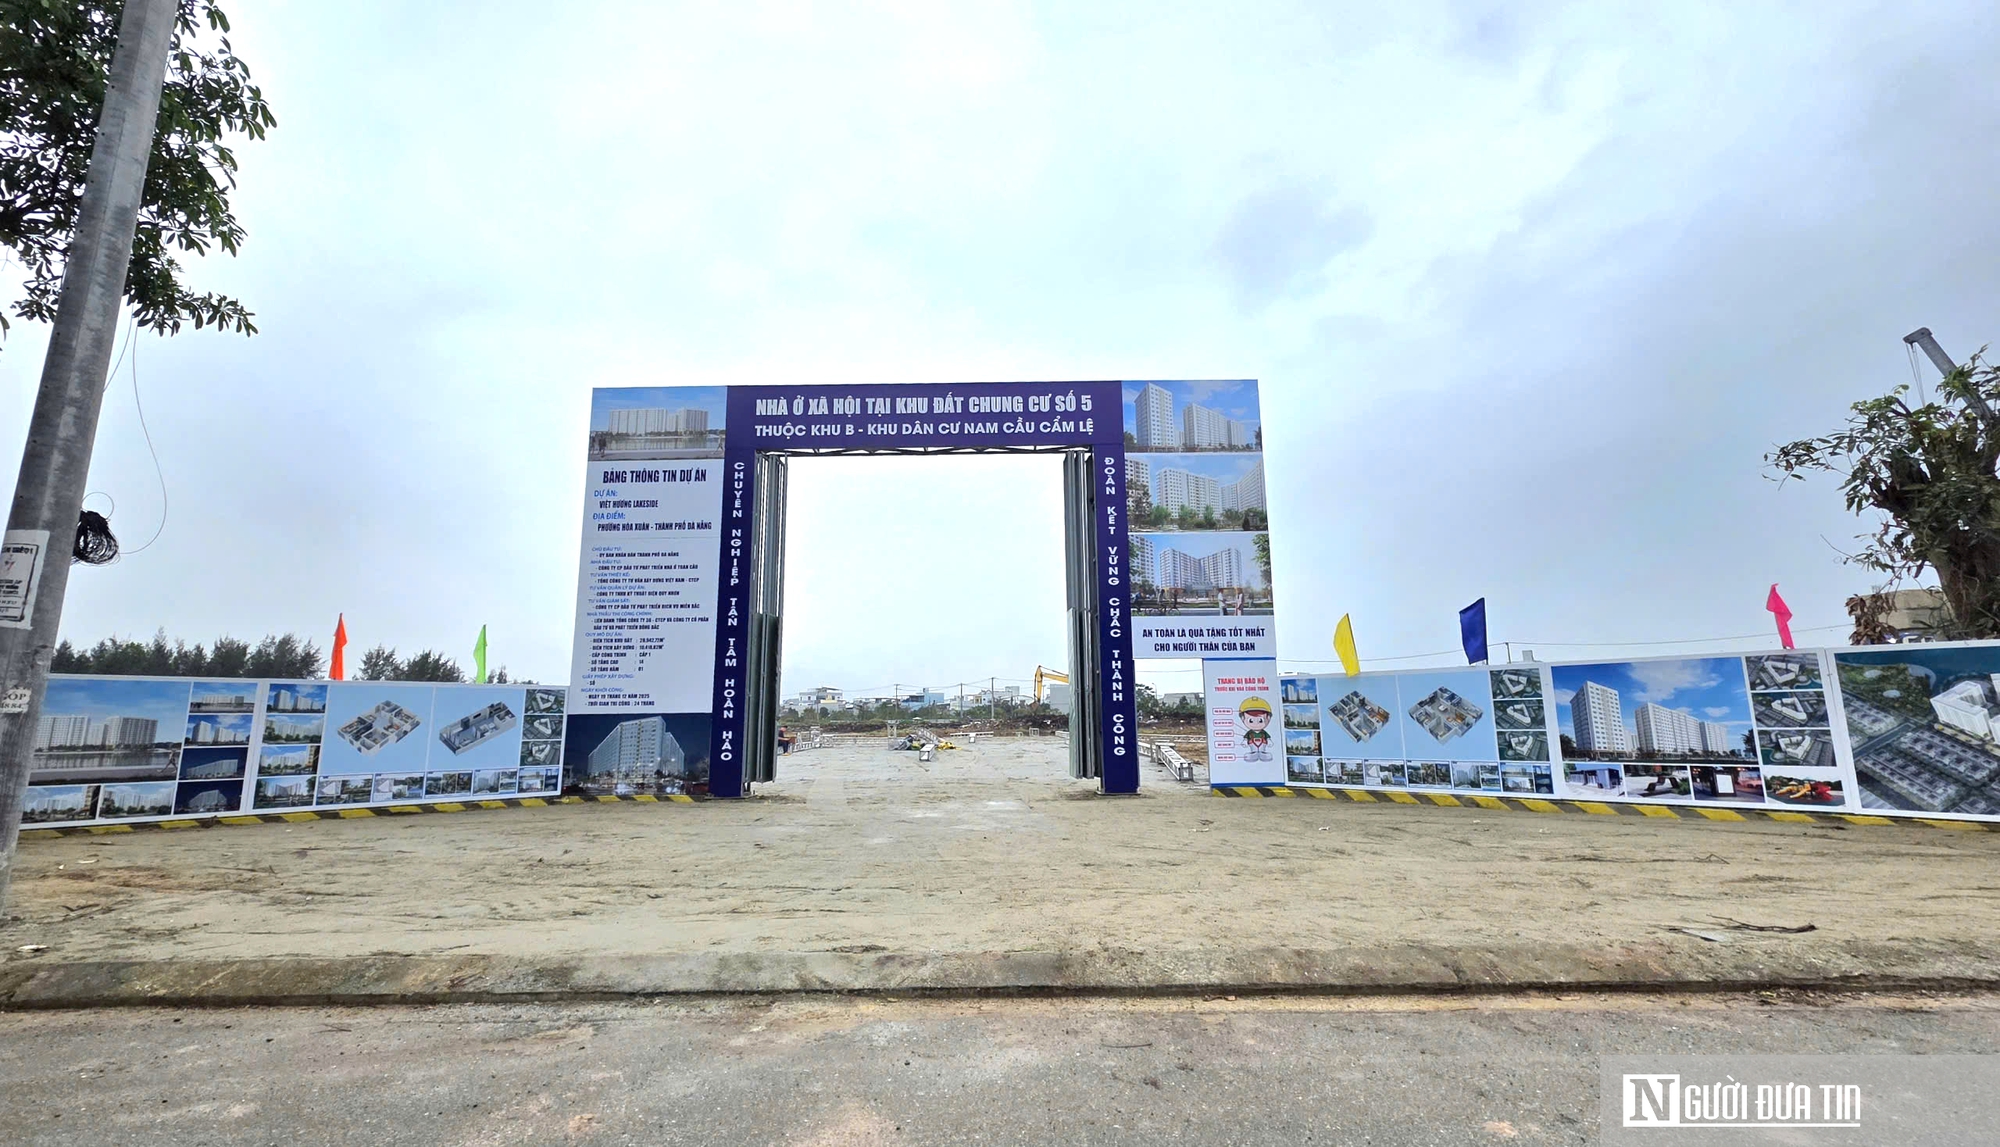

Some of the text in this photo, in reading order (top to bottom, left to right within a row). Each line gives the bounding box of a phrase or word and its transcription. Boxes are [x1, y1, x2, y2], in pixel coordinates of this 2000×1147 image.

[756, 390, 1093, 418] NHÀ Ở XÃ HỘI TẠI KHU ĐẤT CHUNG CƯ SỐ 5
[755, 422, 806, 439] THUỘC
[811, 424, 841, 437] KHU
[846, 424, 855, 436] B
[867, 423, 897, 435] KHU
[902, 419, 934, 435] DÂN
[938, 421, 962, 435] CƯ
[965, 422, 998, 434] NAM
[1002, 416, 1035, 434] CẦU
[1039, 415, 1075, 433] CẨM
[1079, 419, 1094, 436] LỆ
[602, 467, 707, 485] BẢNG THÔNG TIN DỰ ÁN
[594, 488, 618, 499] DỰ ÁN:
[599, 499, 611, 510] VIỆT
[633, 499, 659, 508] LAKESIDE
[593, 510, 626, 522] ĐỊA ĐIỂM:
[597, 522, 621, 532] PHƯỜNG
[621, 521, 633, 531] HÒA
[635, 521, 650, 531] XUÂN
[655, 521, 673, 531] THÀNH
[674, 520, 686, 530] PHỐ
[687, 521, 695, 530] ĐÀ
[696, 519, 712, 530] NẴNG
[720, 461, 745, 761] CHUYÊN NGHIỆP TẬN TÂM HOÀN HẢO
[1103, 457, 1126, 757] ĐOÀN KẾT VỮNG CHẮC THÀNH CÔNG
[1142, 626, 1265, 639] AN TOÀN LÀ QUÀ TẶNG TỐT NHẤT
[1154, 640, 1255, 653] CHO NGƯỜI THÂN CỦA BẠN
[1257, 676, 1265, 684] HỘ
